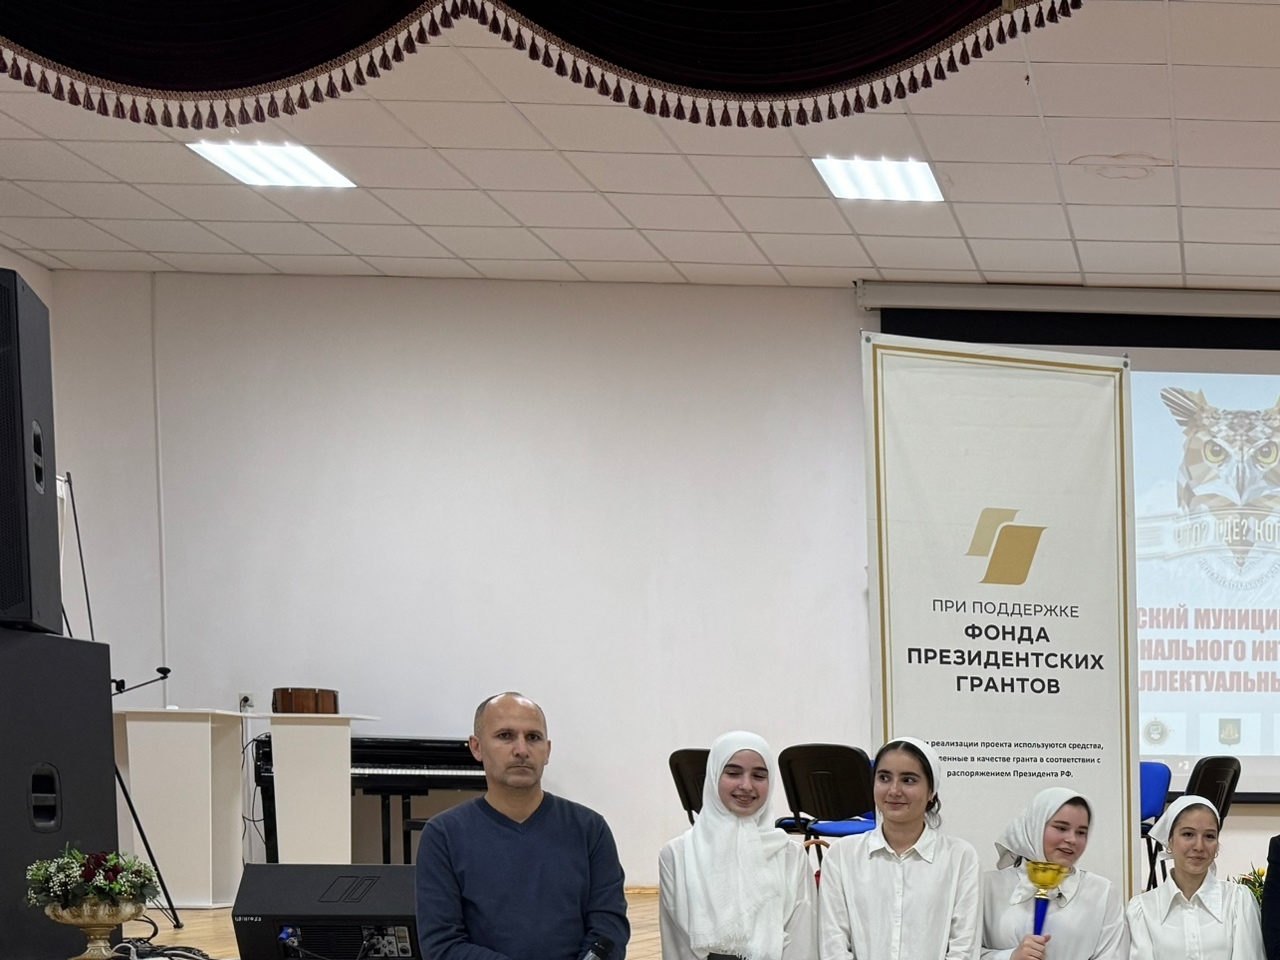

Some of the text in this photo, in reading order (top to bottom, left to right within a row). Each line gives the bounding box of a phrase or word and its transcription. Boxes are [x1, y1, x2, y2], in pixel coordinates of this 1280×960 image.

[1174, 523, 1208, 548] ЧТО?
[1215, 518, 1248, 544] ГДЕ?
[932, 599, 1080, 618] ПРИ ПОДДЕРЖКЕ
[964, 623, 1050, 645] ФОНДА
[907, 648, 1105, 670] ПРЕЗИДЕНТСКИХ
[1139, 639, 1247, 662] НАЛЬНОГО
[956, 675, 1061, 694] ГРАНТОВ
[930, 740, 979, 748] реализации
[980, 741, 1012, 749] проекта
[1013, 742, 1067, 750] используются
[1068, 742, 1104, 751] средства,
[1012, 756, 1038, 764] гранта
[1045, 756, 1096, 764] соответствии
[946, 769, 1074, 779] распоряжением Президента РФ.
